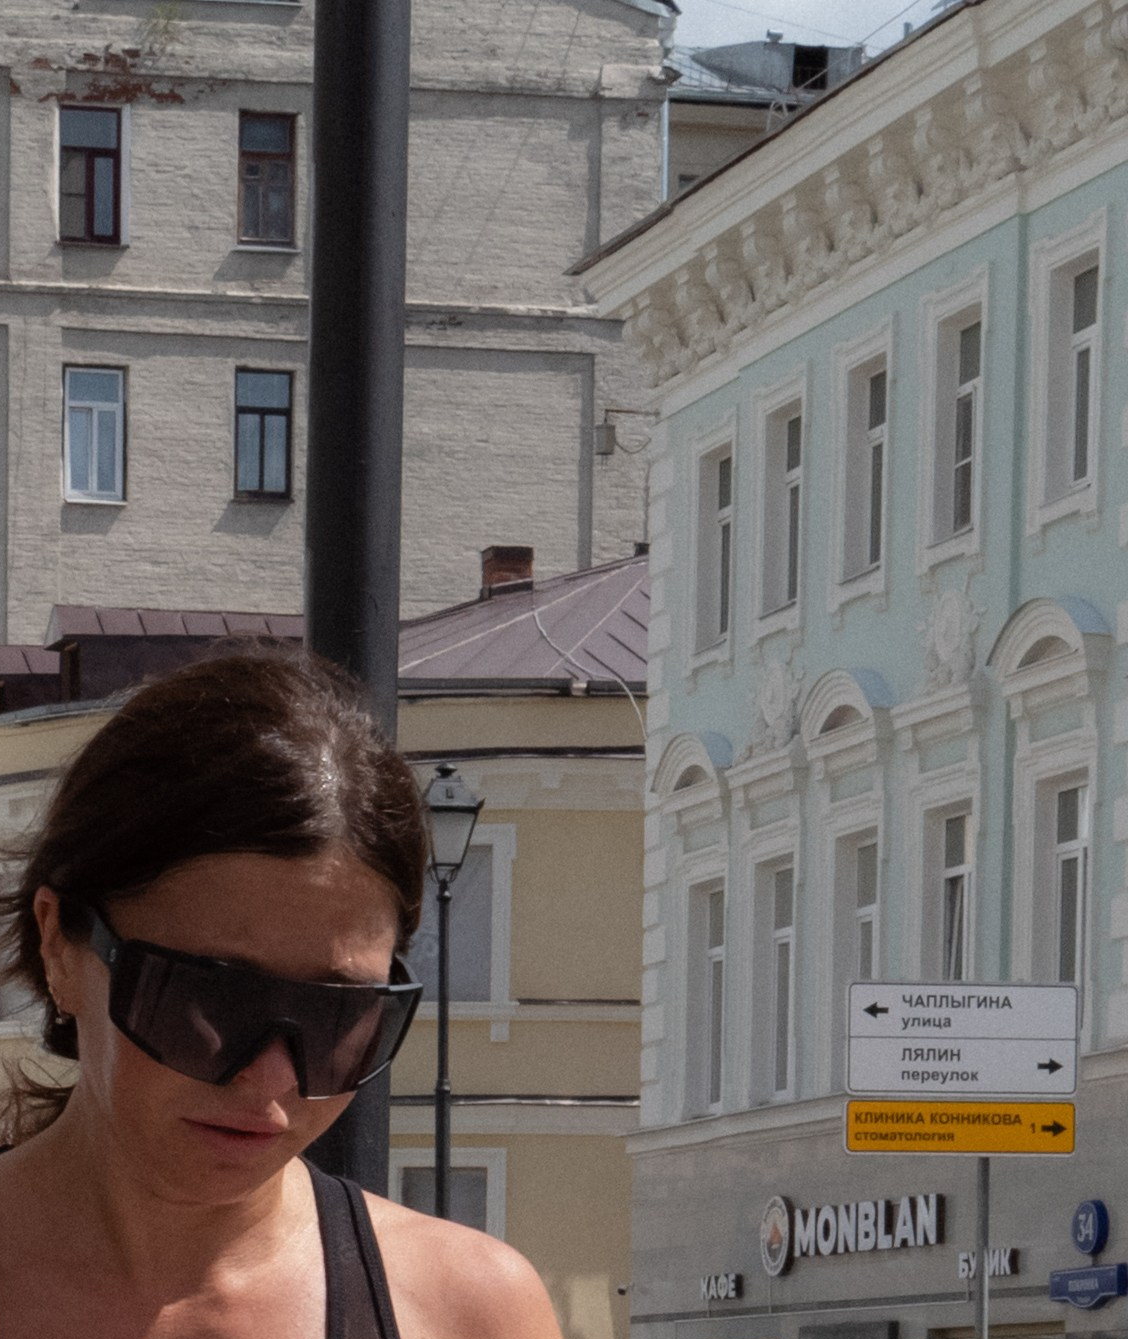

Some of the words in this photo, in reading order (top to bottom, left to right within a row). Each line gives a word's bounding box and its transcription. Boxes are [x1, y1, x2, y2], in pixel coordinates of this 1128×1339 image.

[902, 994, 1013, 1010] ЧАПЛЫГИНА
[902, 1016, 952, 1031] улица
[901, 1047, 961, 1062] ЛЯЛИН
[901, 1070, 979, 1085] переулок
[854, 1111, 925, 1124] КЛИНИКА
[930, 1112, 1022, 1126] КОННИКОВА
[854, 1131, 955, 1142] стоматология
[793, 1193, 937, 1258] MONBLAN
[1077, 1213, 1093, 1242] 34
[959, 1249, 1011, 1278] БУИК
[701, 1273, 736, 1300] КАФЕ
